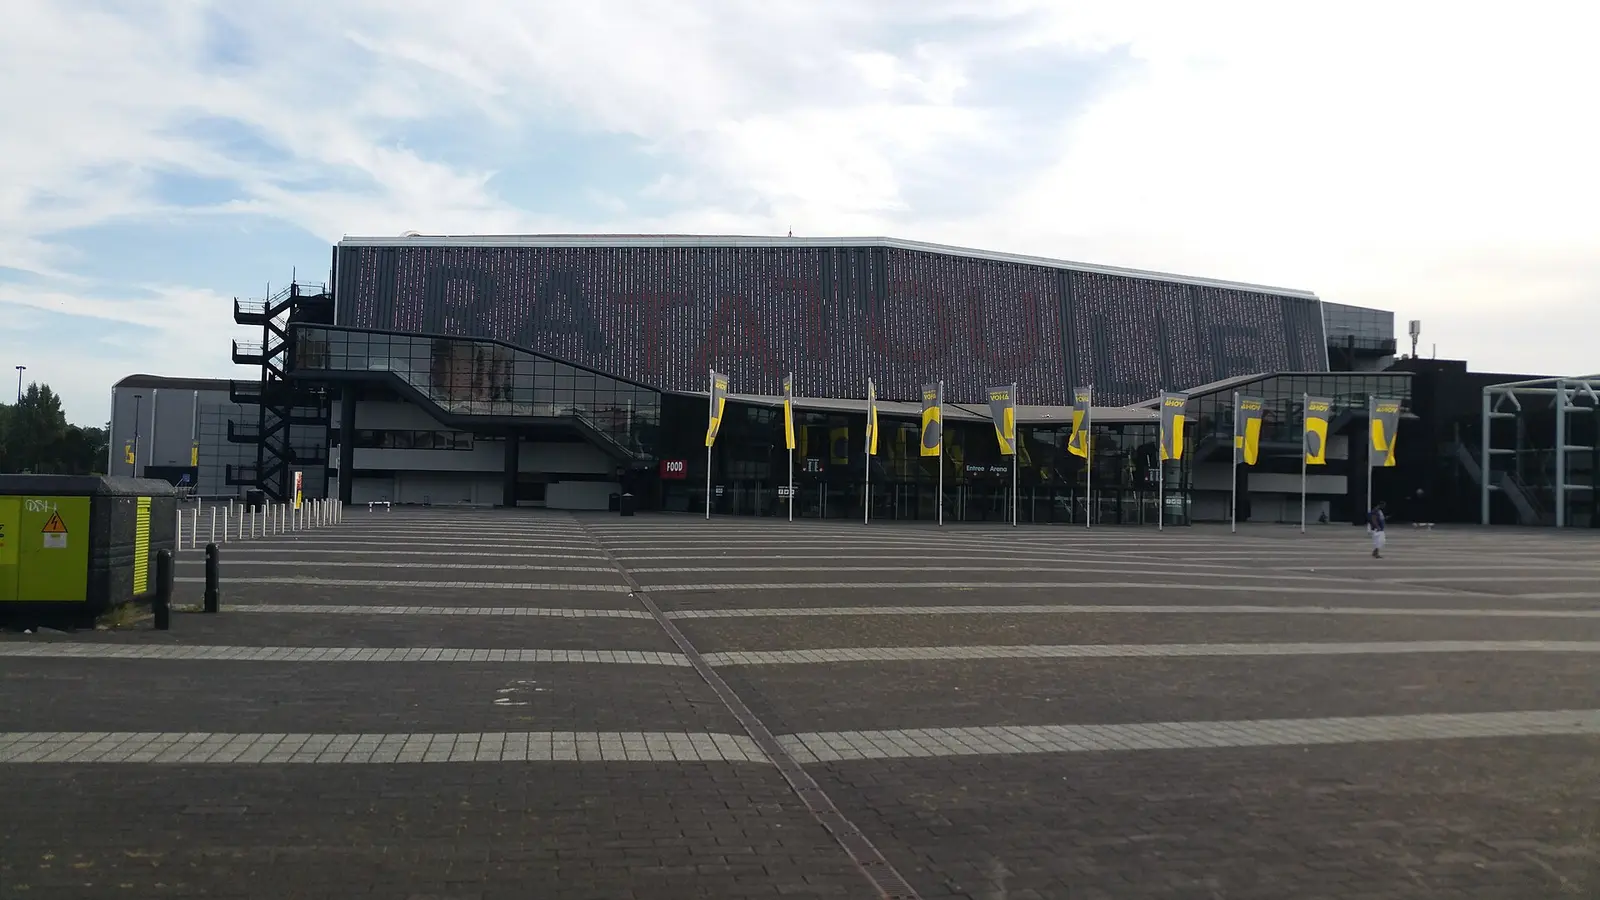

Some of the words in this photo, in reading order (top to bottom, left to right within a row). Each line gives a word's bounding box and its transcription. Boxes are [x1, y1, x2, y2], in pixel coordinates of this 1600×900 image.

[1164, 399, 1185, 408] AHOY
[1240, 403, 1261, 411] AHOY
[1308, 404, 1328, 412] AHOY
[666, 461, 683, 472] FOOD
